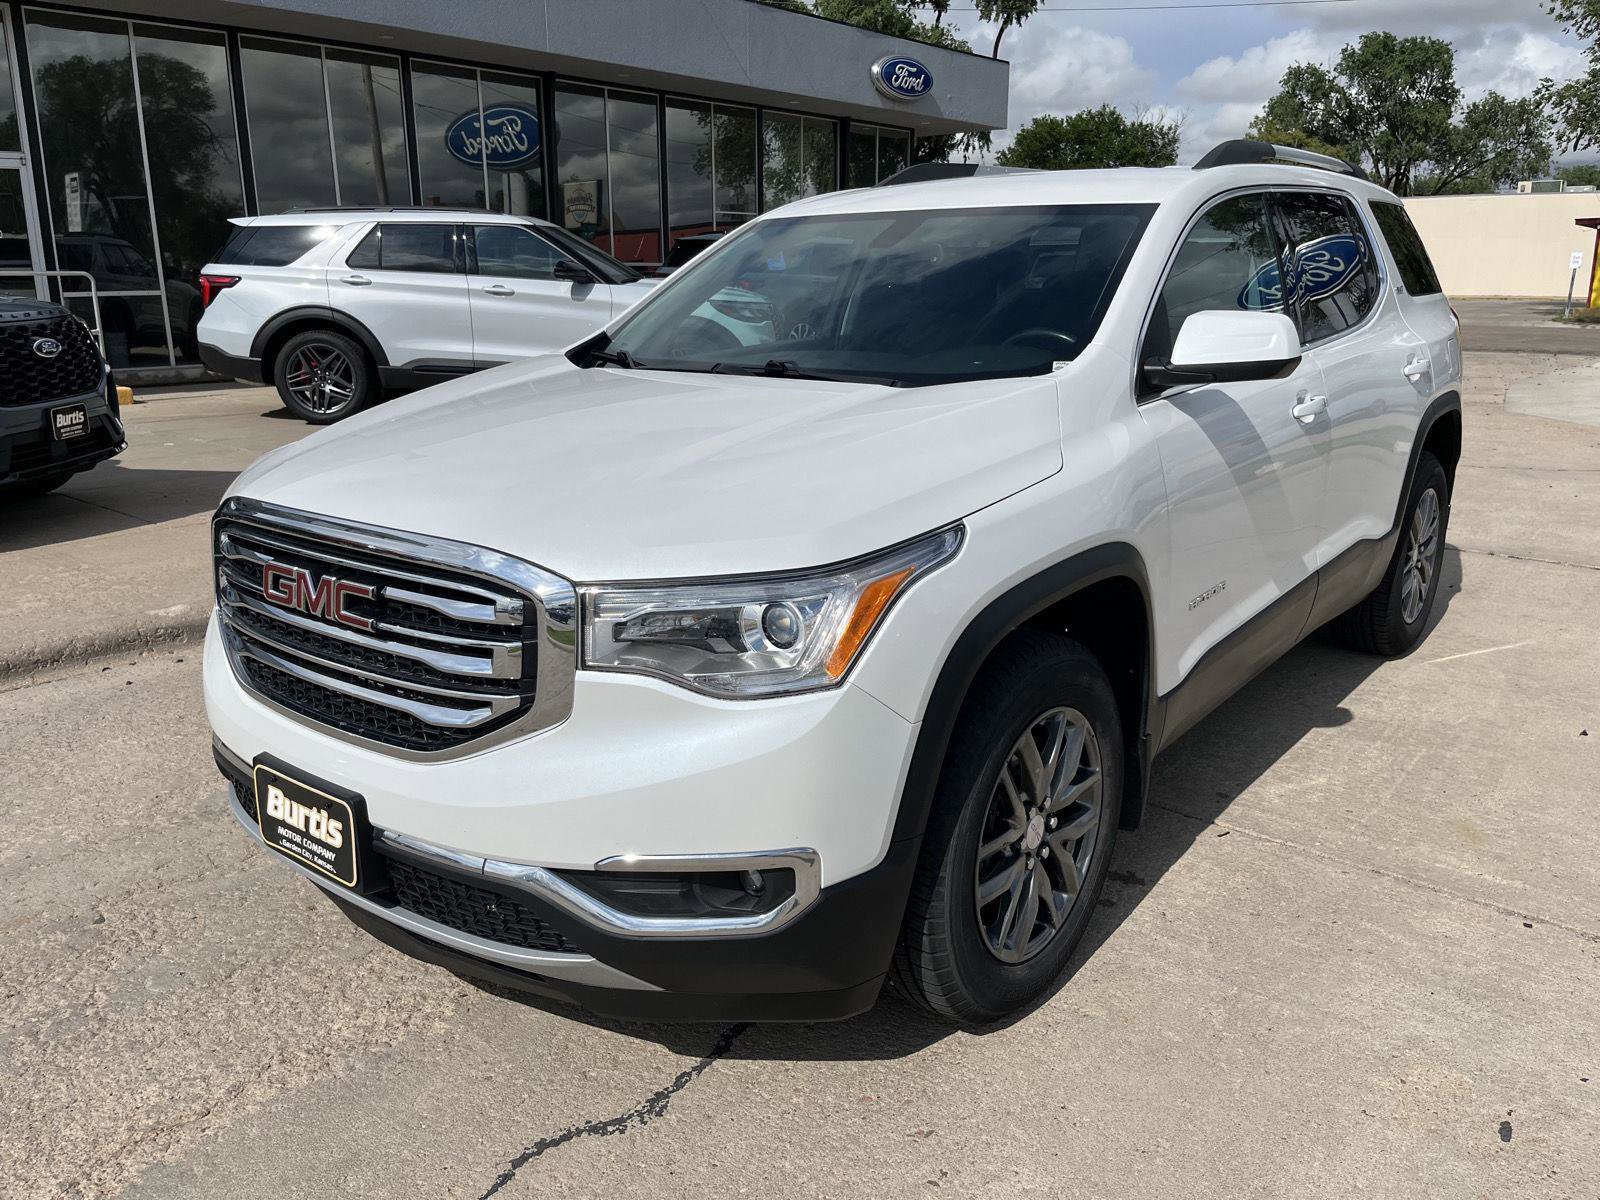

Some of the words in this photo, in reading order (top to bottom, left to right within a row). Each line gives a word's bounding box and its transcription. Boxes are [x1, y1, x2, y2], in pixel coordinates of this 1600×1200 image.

[891, 63, 925, 91] Ford
[56, 410, 85, 428] Burtis
[263, 560, 377, 633] GMC
[266, 784, 343, 849] Burtis
[277, 825, 302, 844] MOTOR
[302, 837, 337, 862] COMPANY
[282, 838, 302, 854] Garden
